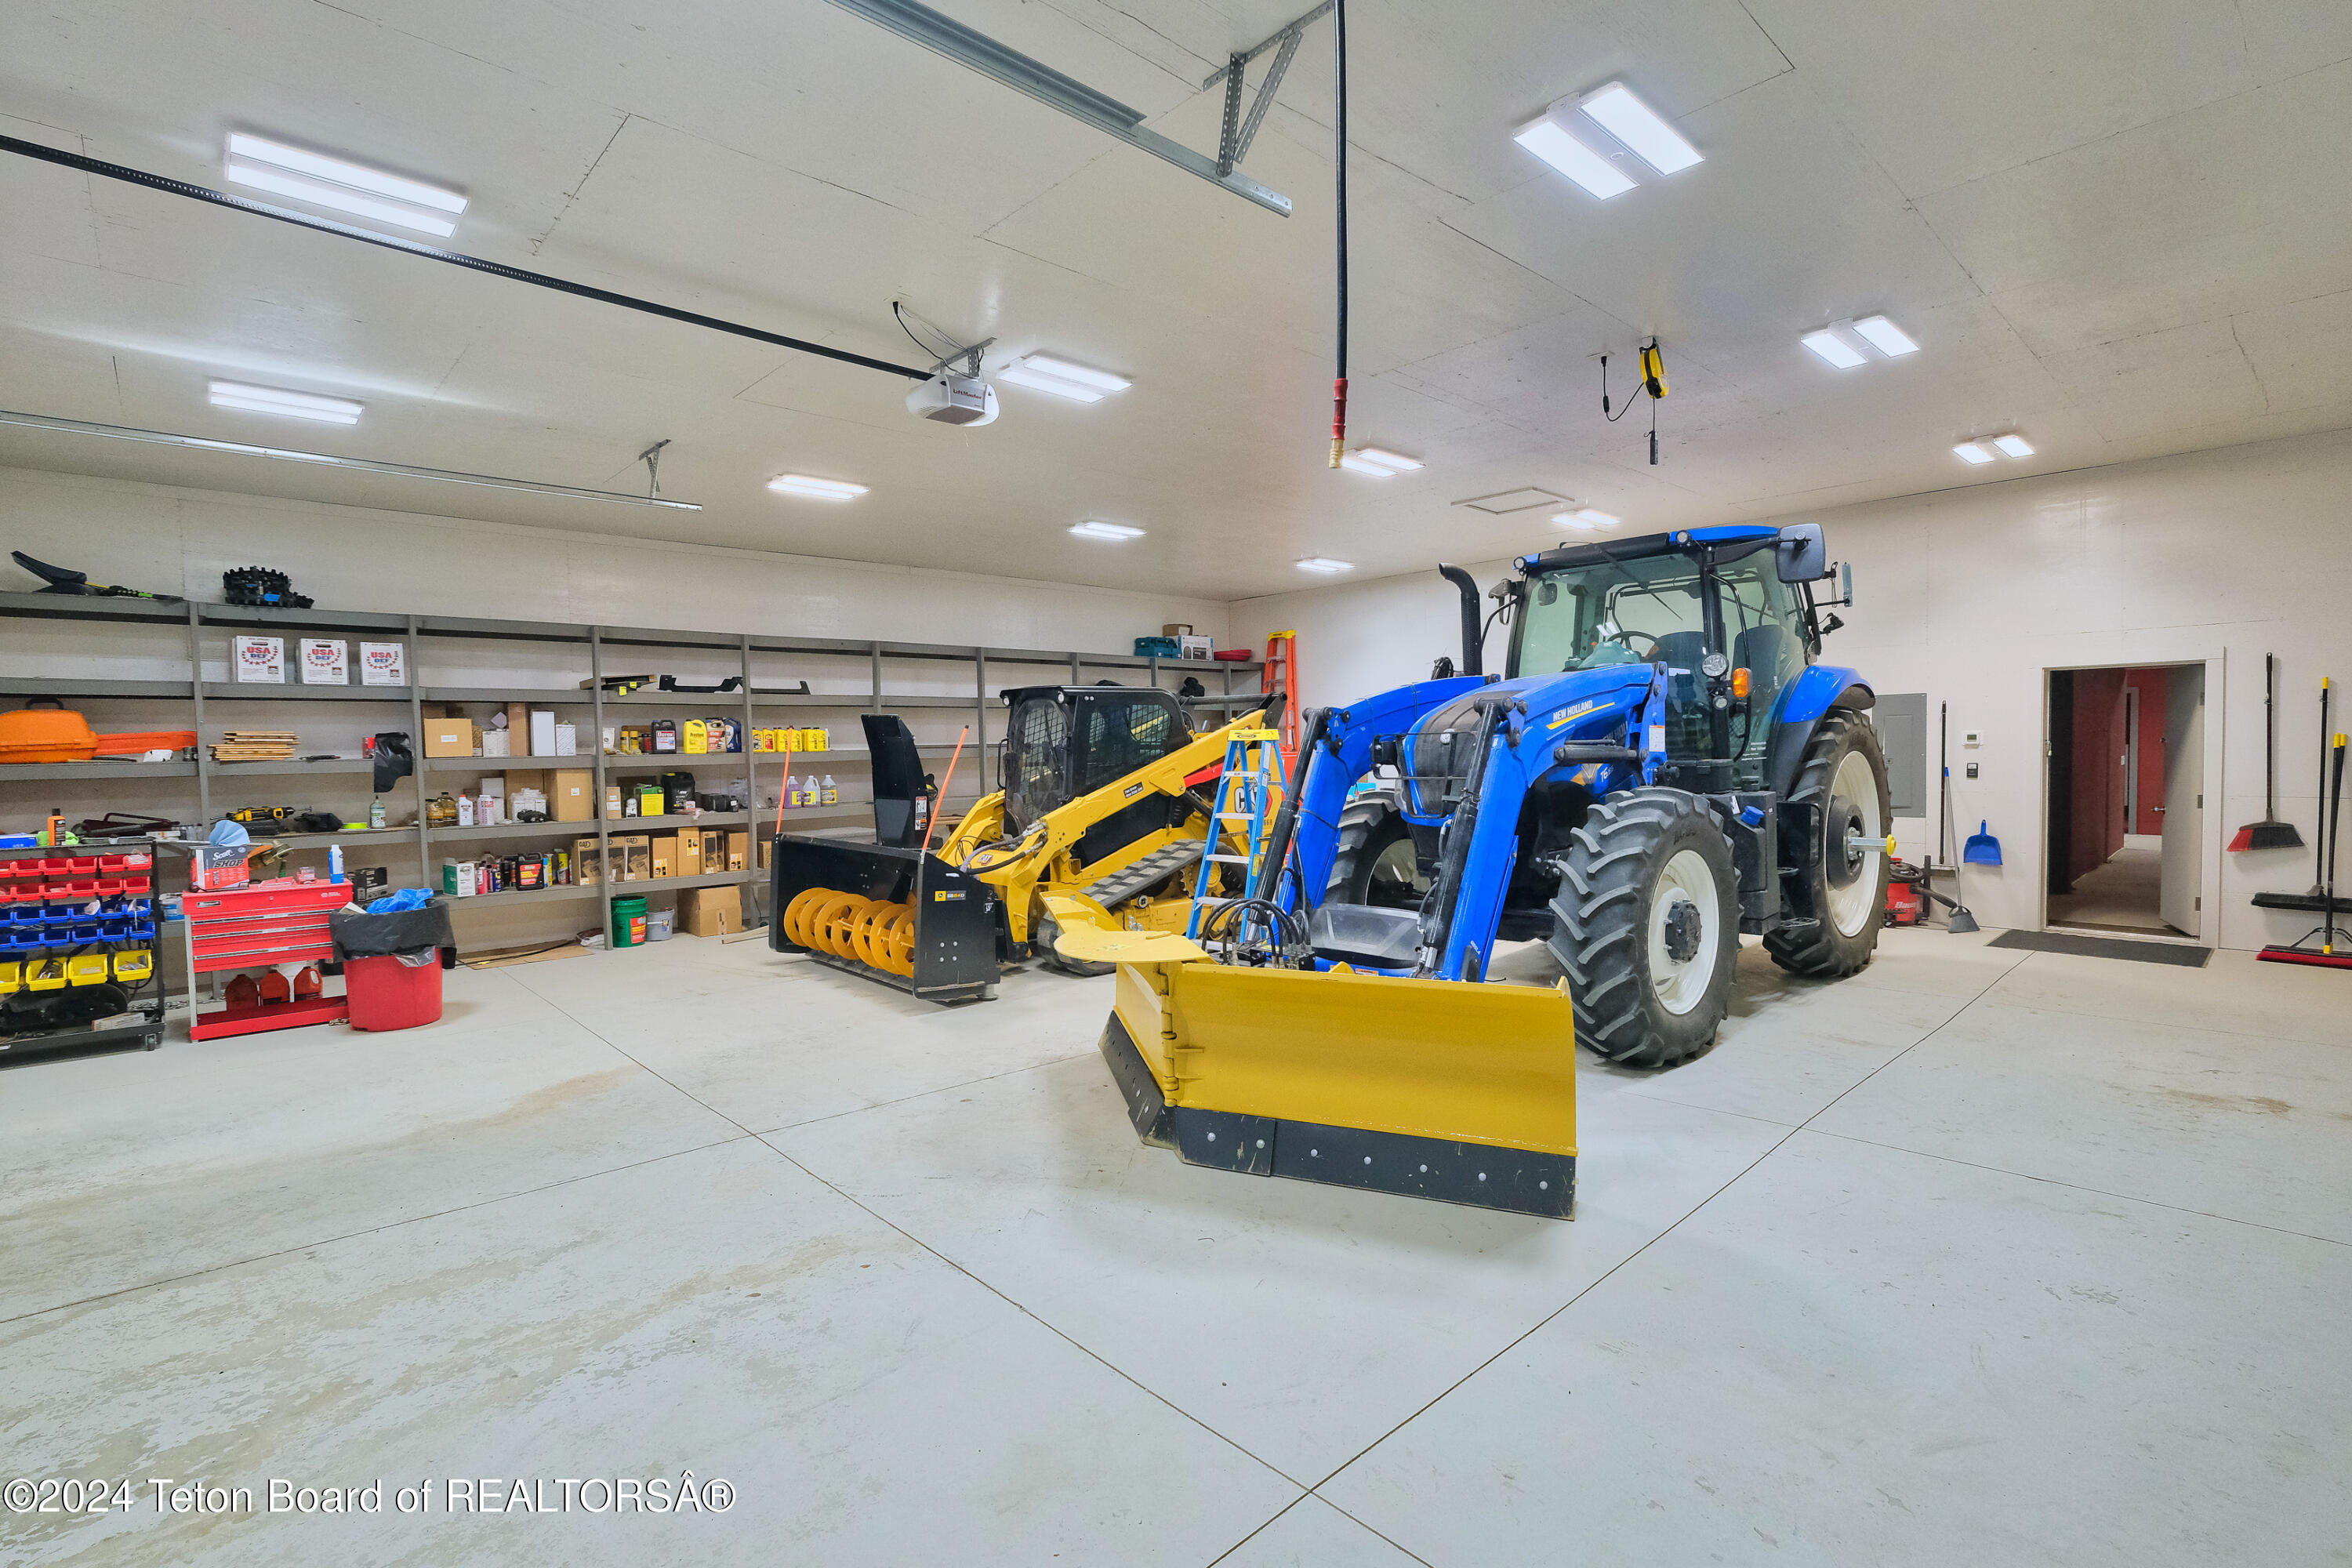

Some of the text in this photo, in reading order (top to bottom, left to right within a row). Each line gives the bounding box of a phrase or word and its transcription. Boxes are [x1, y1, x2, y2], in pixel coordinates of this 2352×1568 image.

[953, 388, 982, 400] LiftMaster
[1553, 700, 1592, 721] NEW HOLLAND
[213, 859, 245, 868] SHOP
[978, 854, 992, 863] CAT
